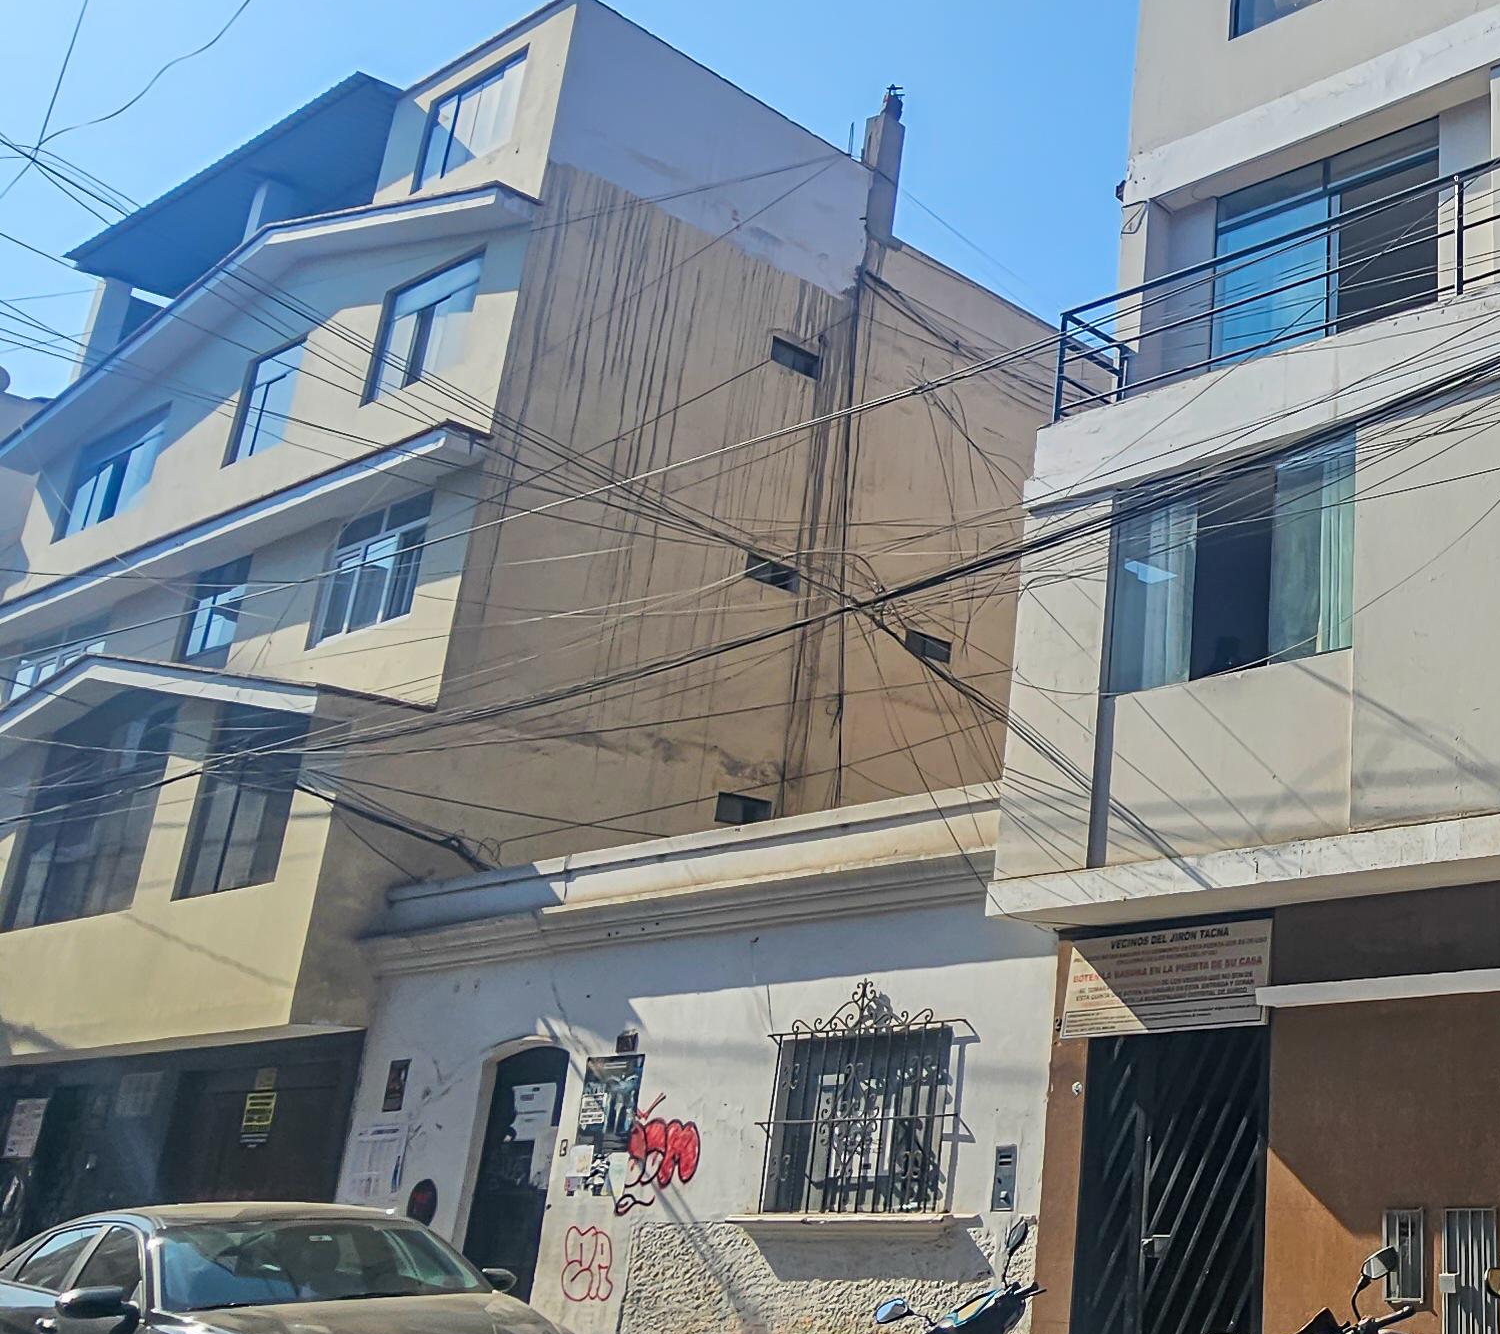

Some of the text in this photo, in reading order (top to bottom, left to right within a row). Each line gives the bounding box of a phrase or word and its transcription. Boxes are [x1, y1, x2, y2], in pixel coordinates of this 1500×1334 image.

[1110, 935, 1149, 949] VECINOS
[1150, 933, 1167, 945] DEL
[1200, 926, 1229, 939] TACNA
[1162, 964, 1173, 974] LA
[1175, 961, 1209, 973] PUERTA
[1210, 959, 1222, 970] DE
[1224, 958, 1236, 969] SU
[1238, 956, 1262, 967] CASA
